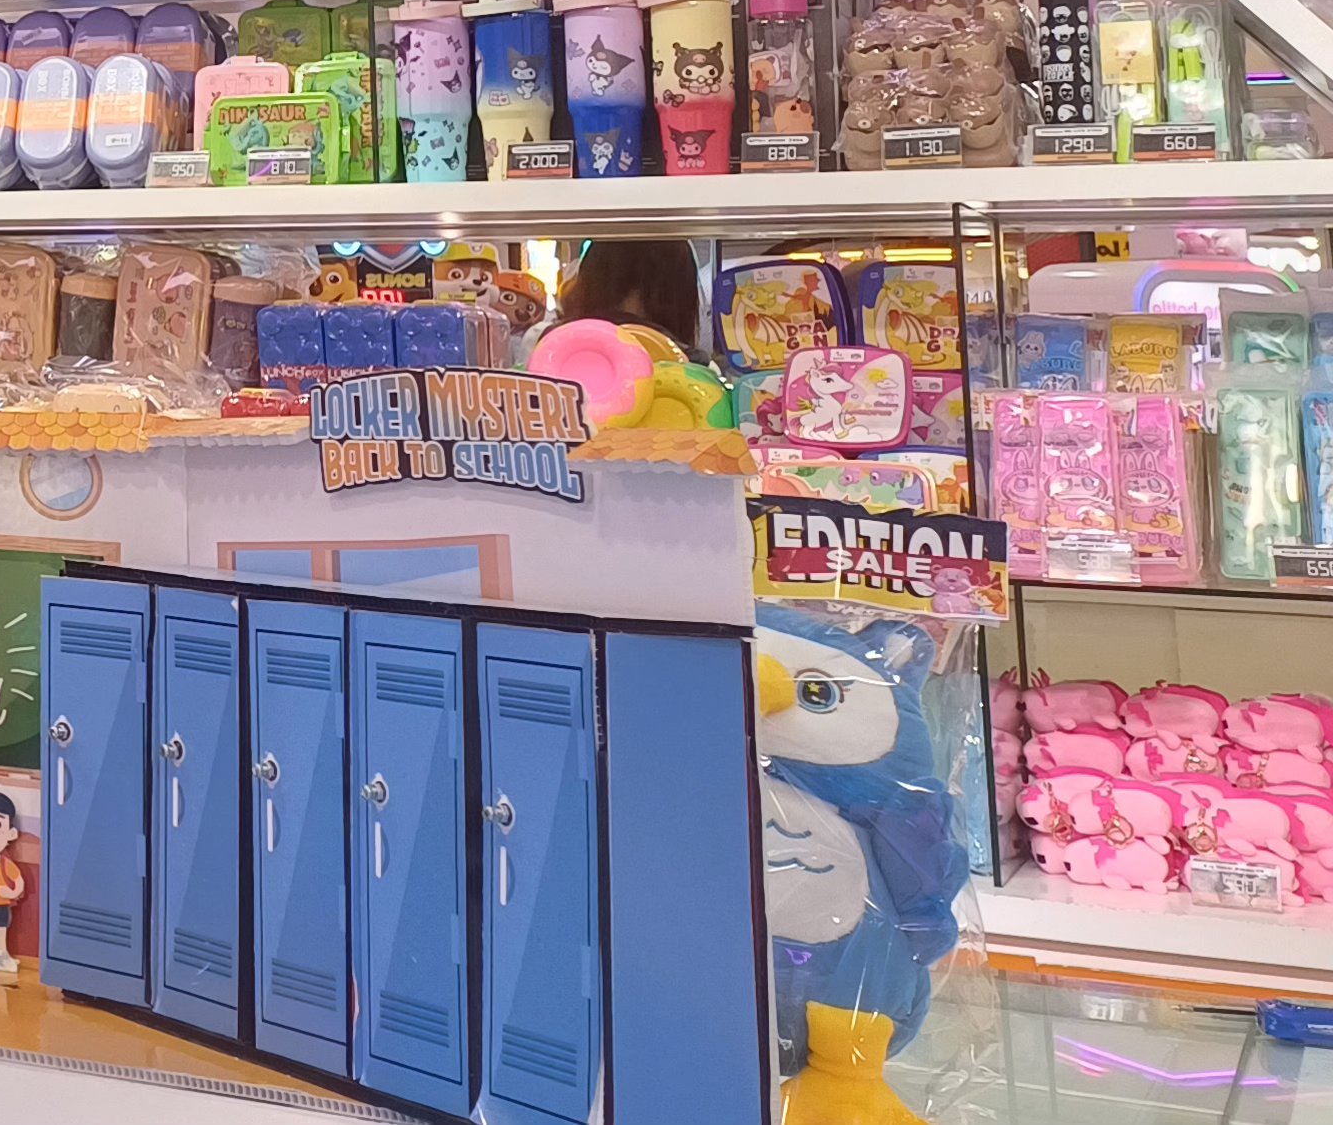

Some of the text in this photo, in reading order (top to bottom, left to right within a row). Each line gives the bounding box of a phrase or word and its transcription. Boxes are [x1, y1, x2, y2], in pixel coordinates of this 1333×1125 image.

[768, 147, 796, 161] 830
[1163, 135, 1197, 150] 660
[311, 371, 586, 442] LOCKER MYSTERI
[322, 440, 581, 500] BACK TO SCHOOL
[826, 550, 932, 579] SALE
